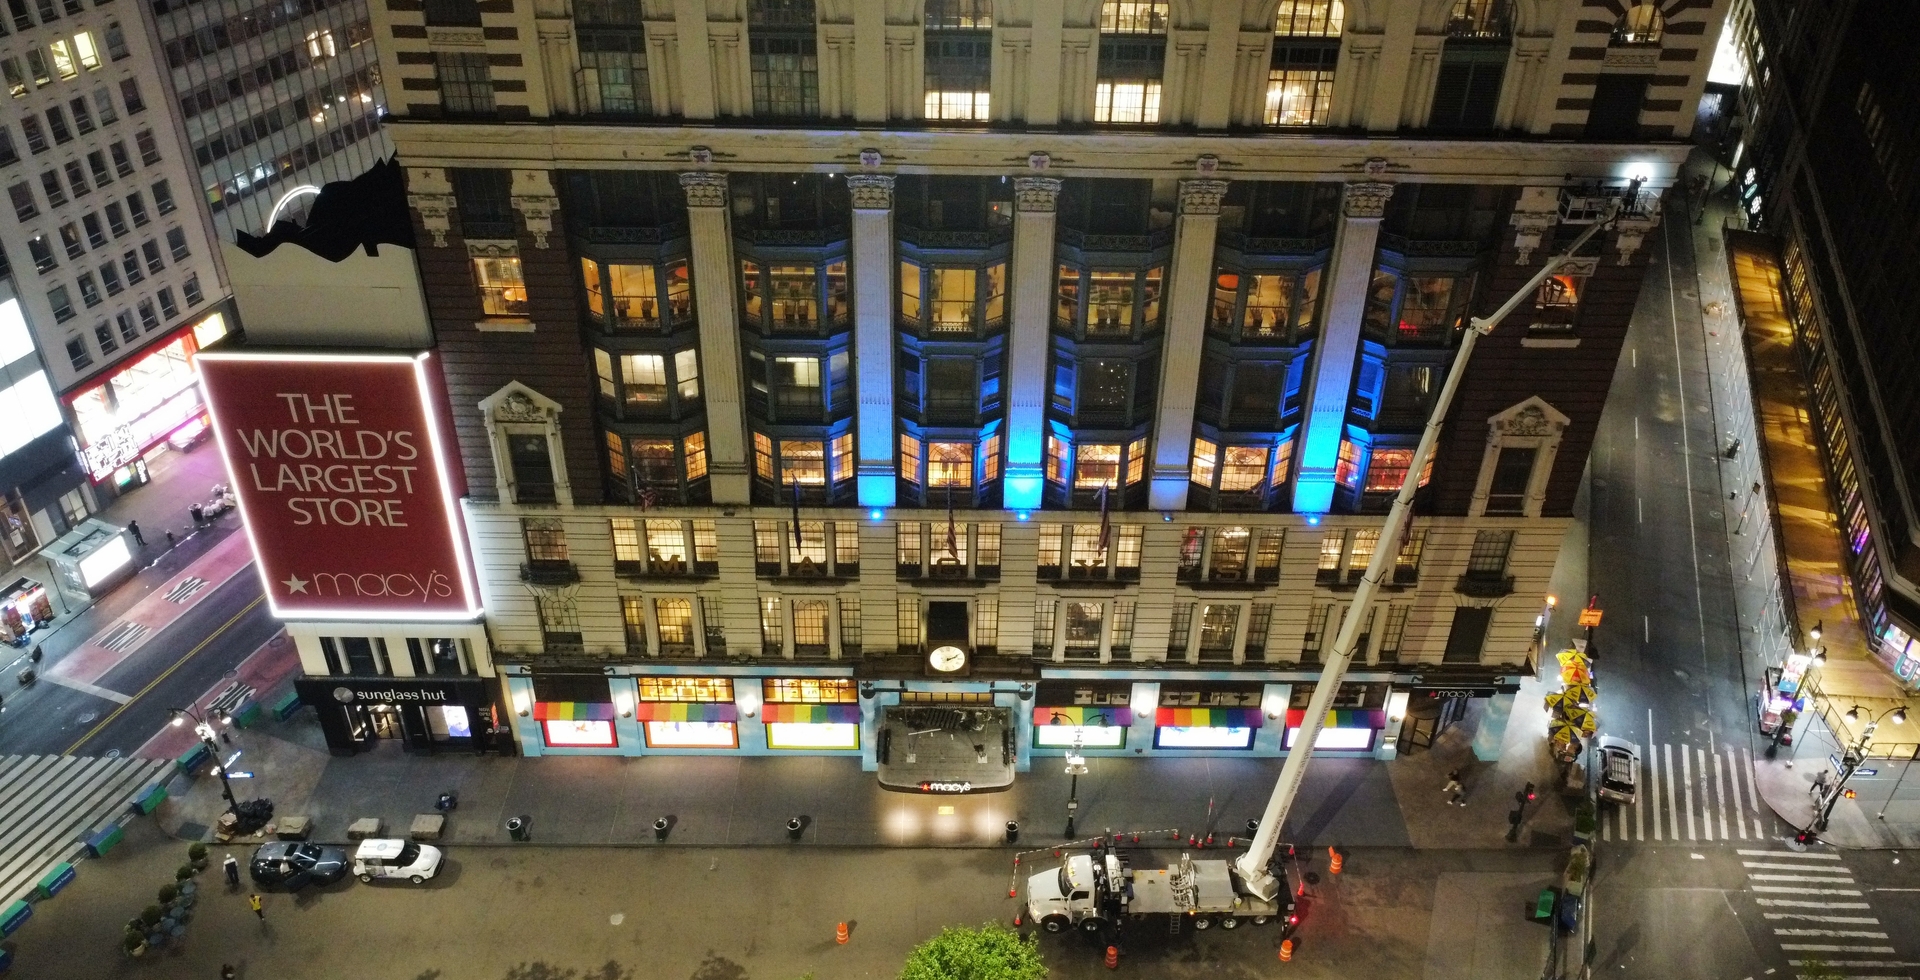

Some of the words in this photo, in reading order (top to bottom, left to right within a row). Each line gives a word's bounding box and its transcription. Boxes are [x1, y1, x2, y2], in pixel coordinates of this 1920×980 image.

[276, 393, 360, 424] THE
[236, 428, 418, 461] WORLD'S
[250, 463, 418, 494] LARGEST
[287, 497, 409, 527] STORE
[161, 575, 211, 605] BUS
[92, 619, 152, 653] ONLY
[204, 681, 257, 715] BUS
[356, 689, 420, 703] sunglass
[420, 689, 447, 701] hut
[930, 781, 972, 794] macy's
